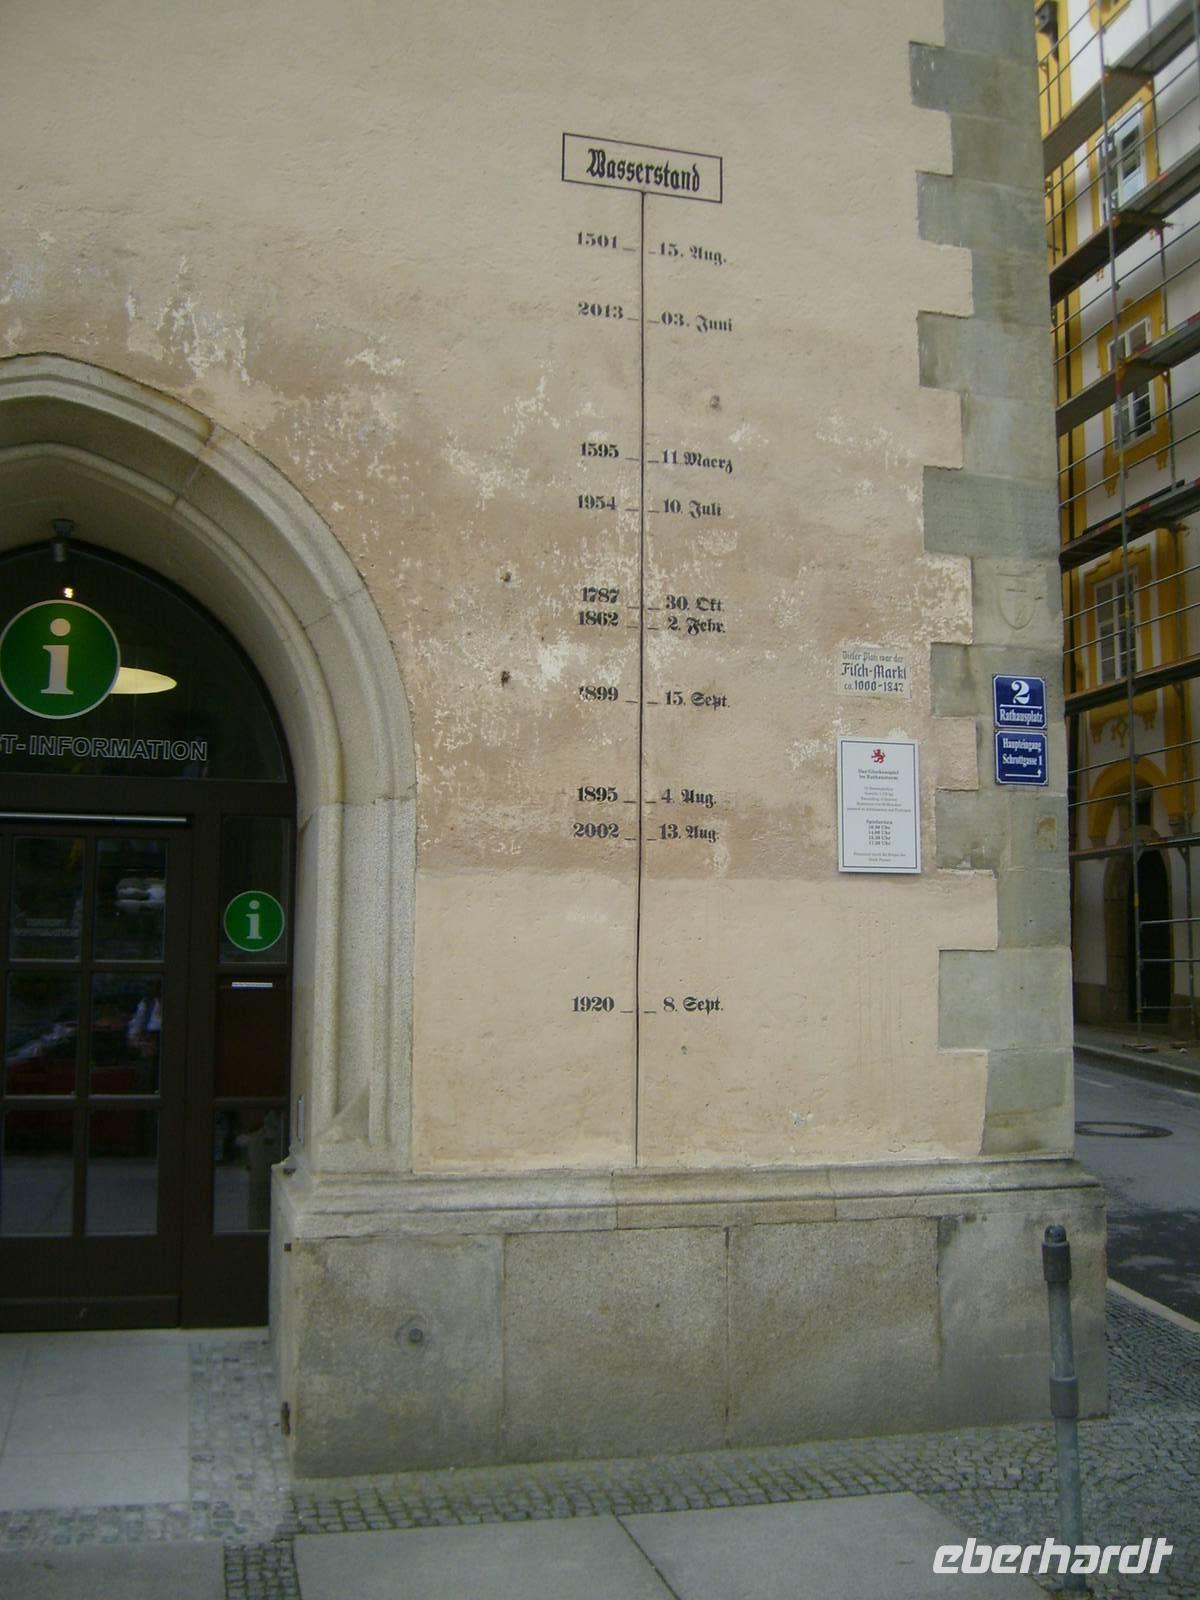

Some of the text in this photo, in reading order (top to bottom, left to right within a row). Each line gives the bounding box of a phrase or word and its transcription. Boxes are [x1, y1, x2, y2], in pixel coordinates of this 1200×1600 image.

[586, 148, 700, 192] Wasserstand
[577, 231, 726, 266] 1501 15. Aug.
[578, 302, 733, 333] 2013 03. Juni
[581, 442, 619, 458] 1595
[578, 495, 616, 510] 1954
[689, 500, 721, 519] Juli
[582, 587, 620, 604] 1787
[666, 595, 690, 611] 30.
[579, 610, 619, 626] 1862
[667, 616, 681, 631] 2.
[579, 686, 619, 702] 1899
[691, 691, 730, 711] Sept.
[1011, 680, 1030, 704] 2
[1000, 708, 1043, 725] Rathausplatz
[0, 734, 208, 761] T-INFORMATION
[577, 785, 618, 802] 1895
[681, 788, 717, 808] Aug.
[573, 823, 720, 843] 2002 13. Aug.
[572, 996, 724, 1016] 1920 8. Sept.
